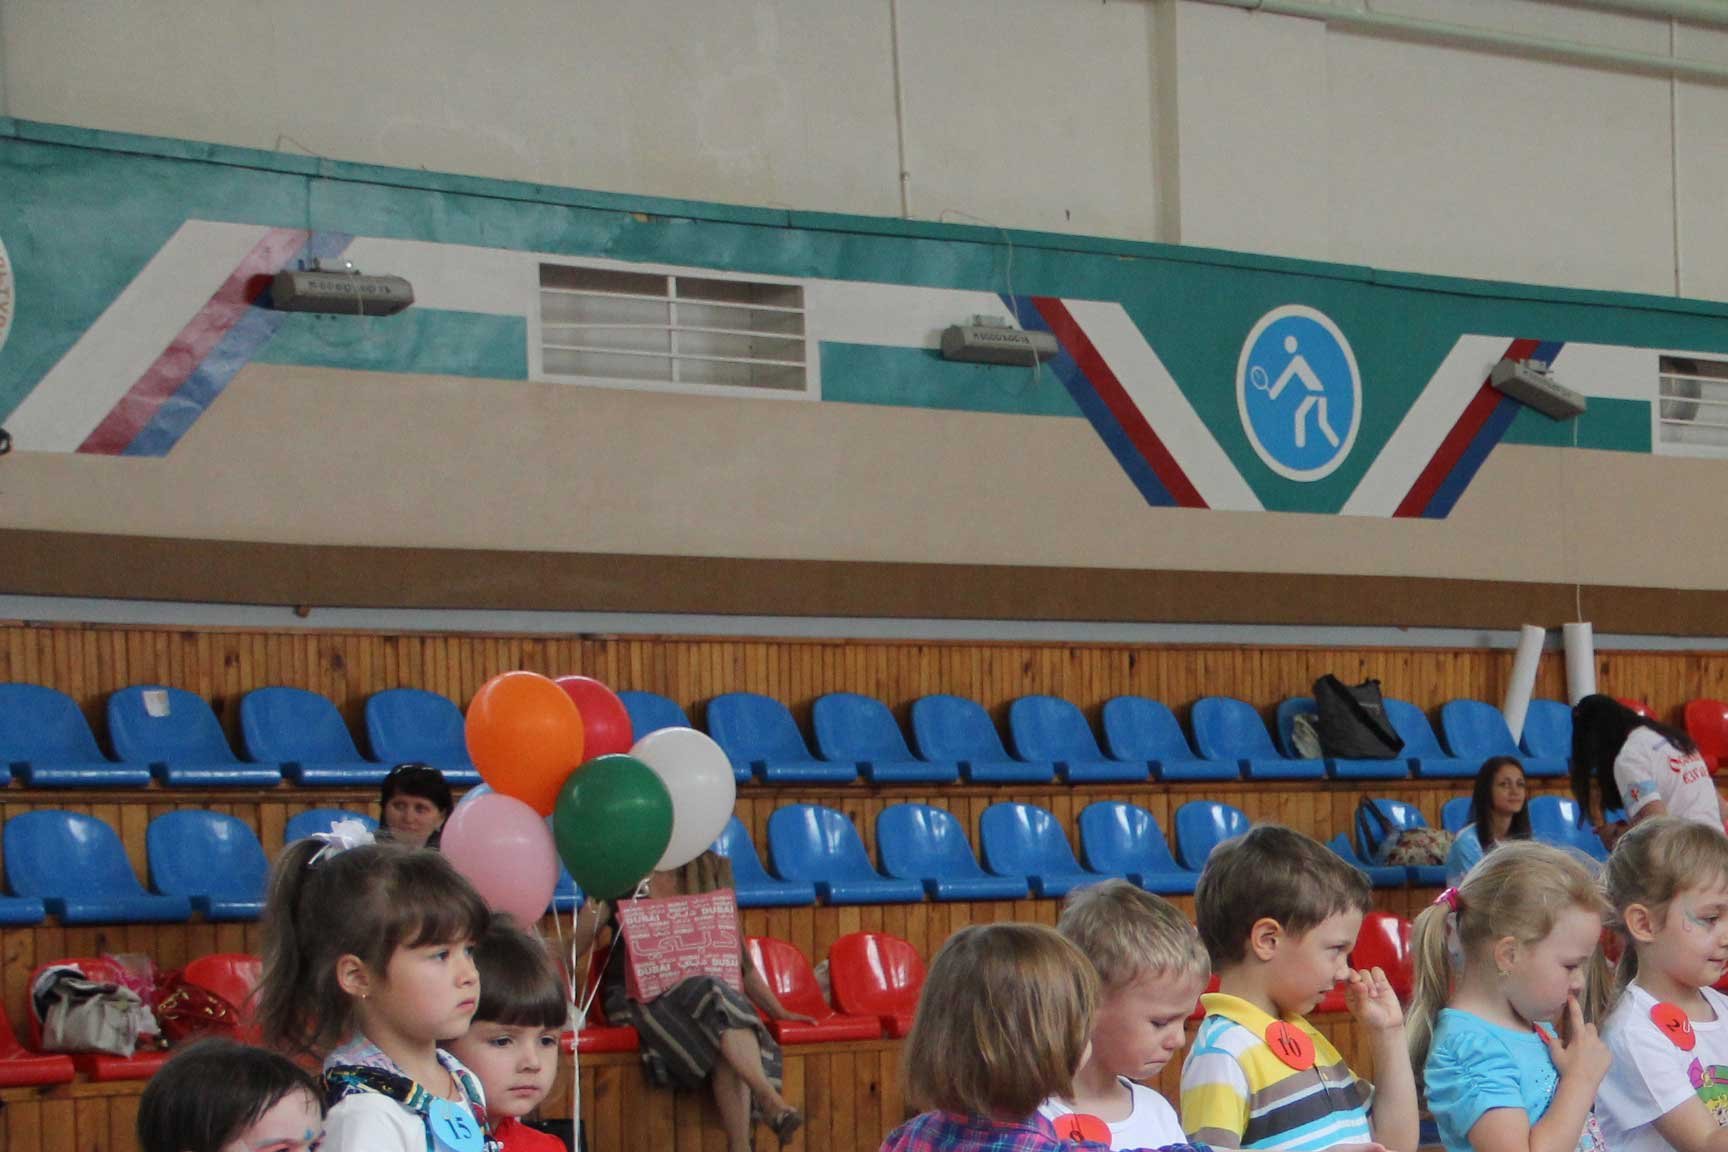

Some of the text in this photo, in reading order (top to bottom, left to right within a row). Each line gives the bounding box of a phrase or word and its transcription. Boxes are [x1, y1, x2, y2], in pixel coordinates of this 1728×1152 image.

[702, 904, 734, 915] DUBAI
[626, 913, 660, 925] DUBAI
[637, 964, 671, 977] DUBAI
[1665, 1018, 1681, 1032] 2
[1277, 1037, 1302, 1058] 10
[444, 1116, 473, 1140] 15
